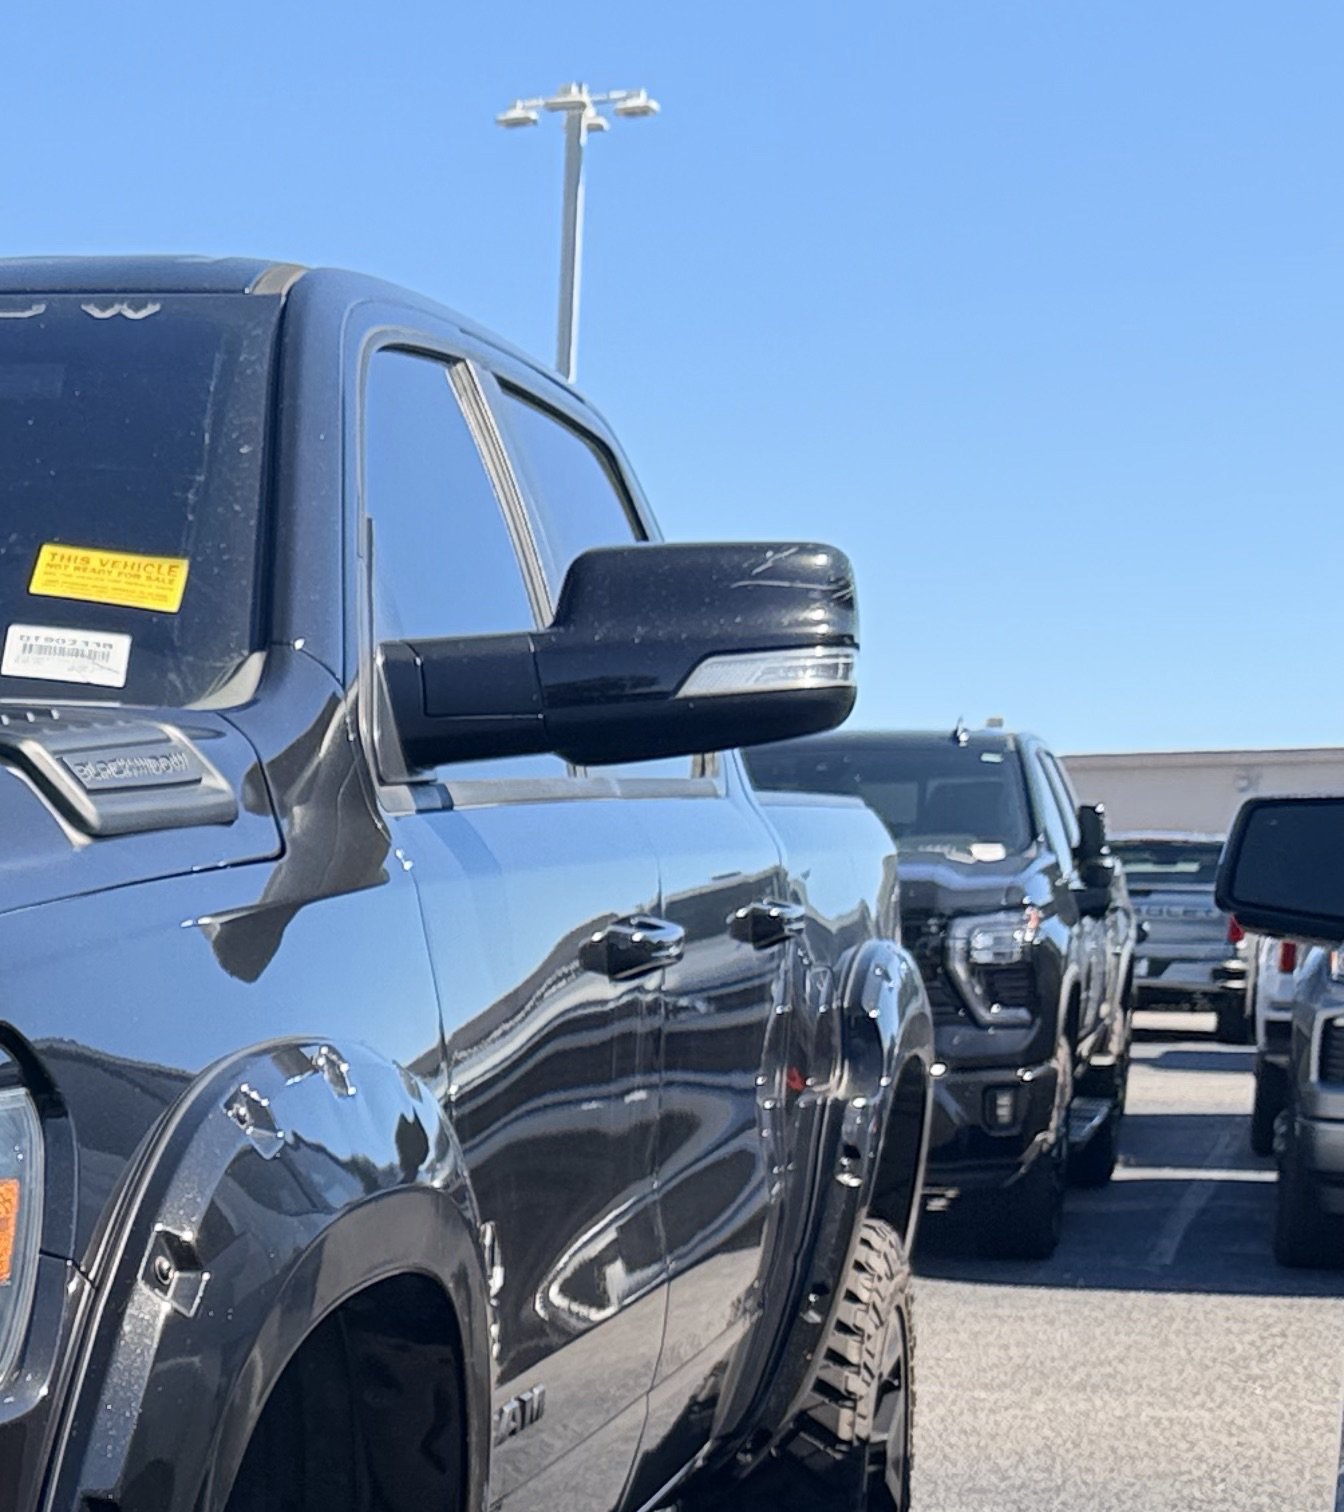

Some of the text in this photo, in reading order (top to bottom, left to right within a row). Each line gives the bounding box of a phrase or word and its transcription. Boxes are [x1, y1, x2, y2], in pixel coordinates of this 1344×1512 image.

[48, 552, 179, 576] THIS VEHICLE
[72, 565, 112, 575] READY
[117, 570, 141, 579] FOR
[144, 575, 175, 584] SALE
